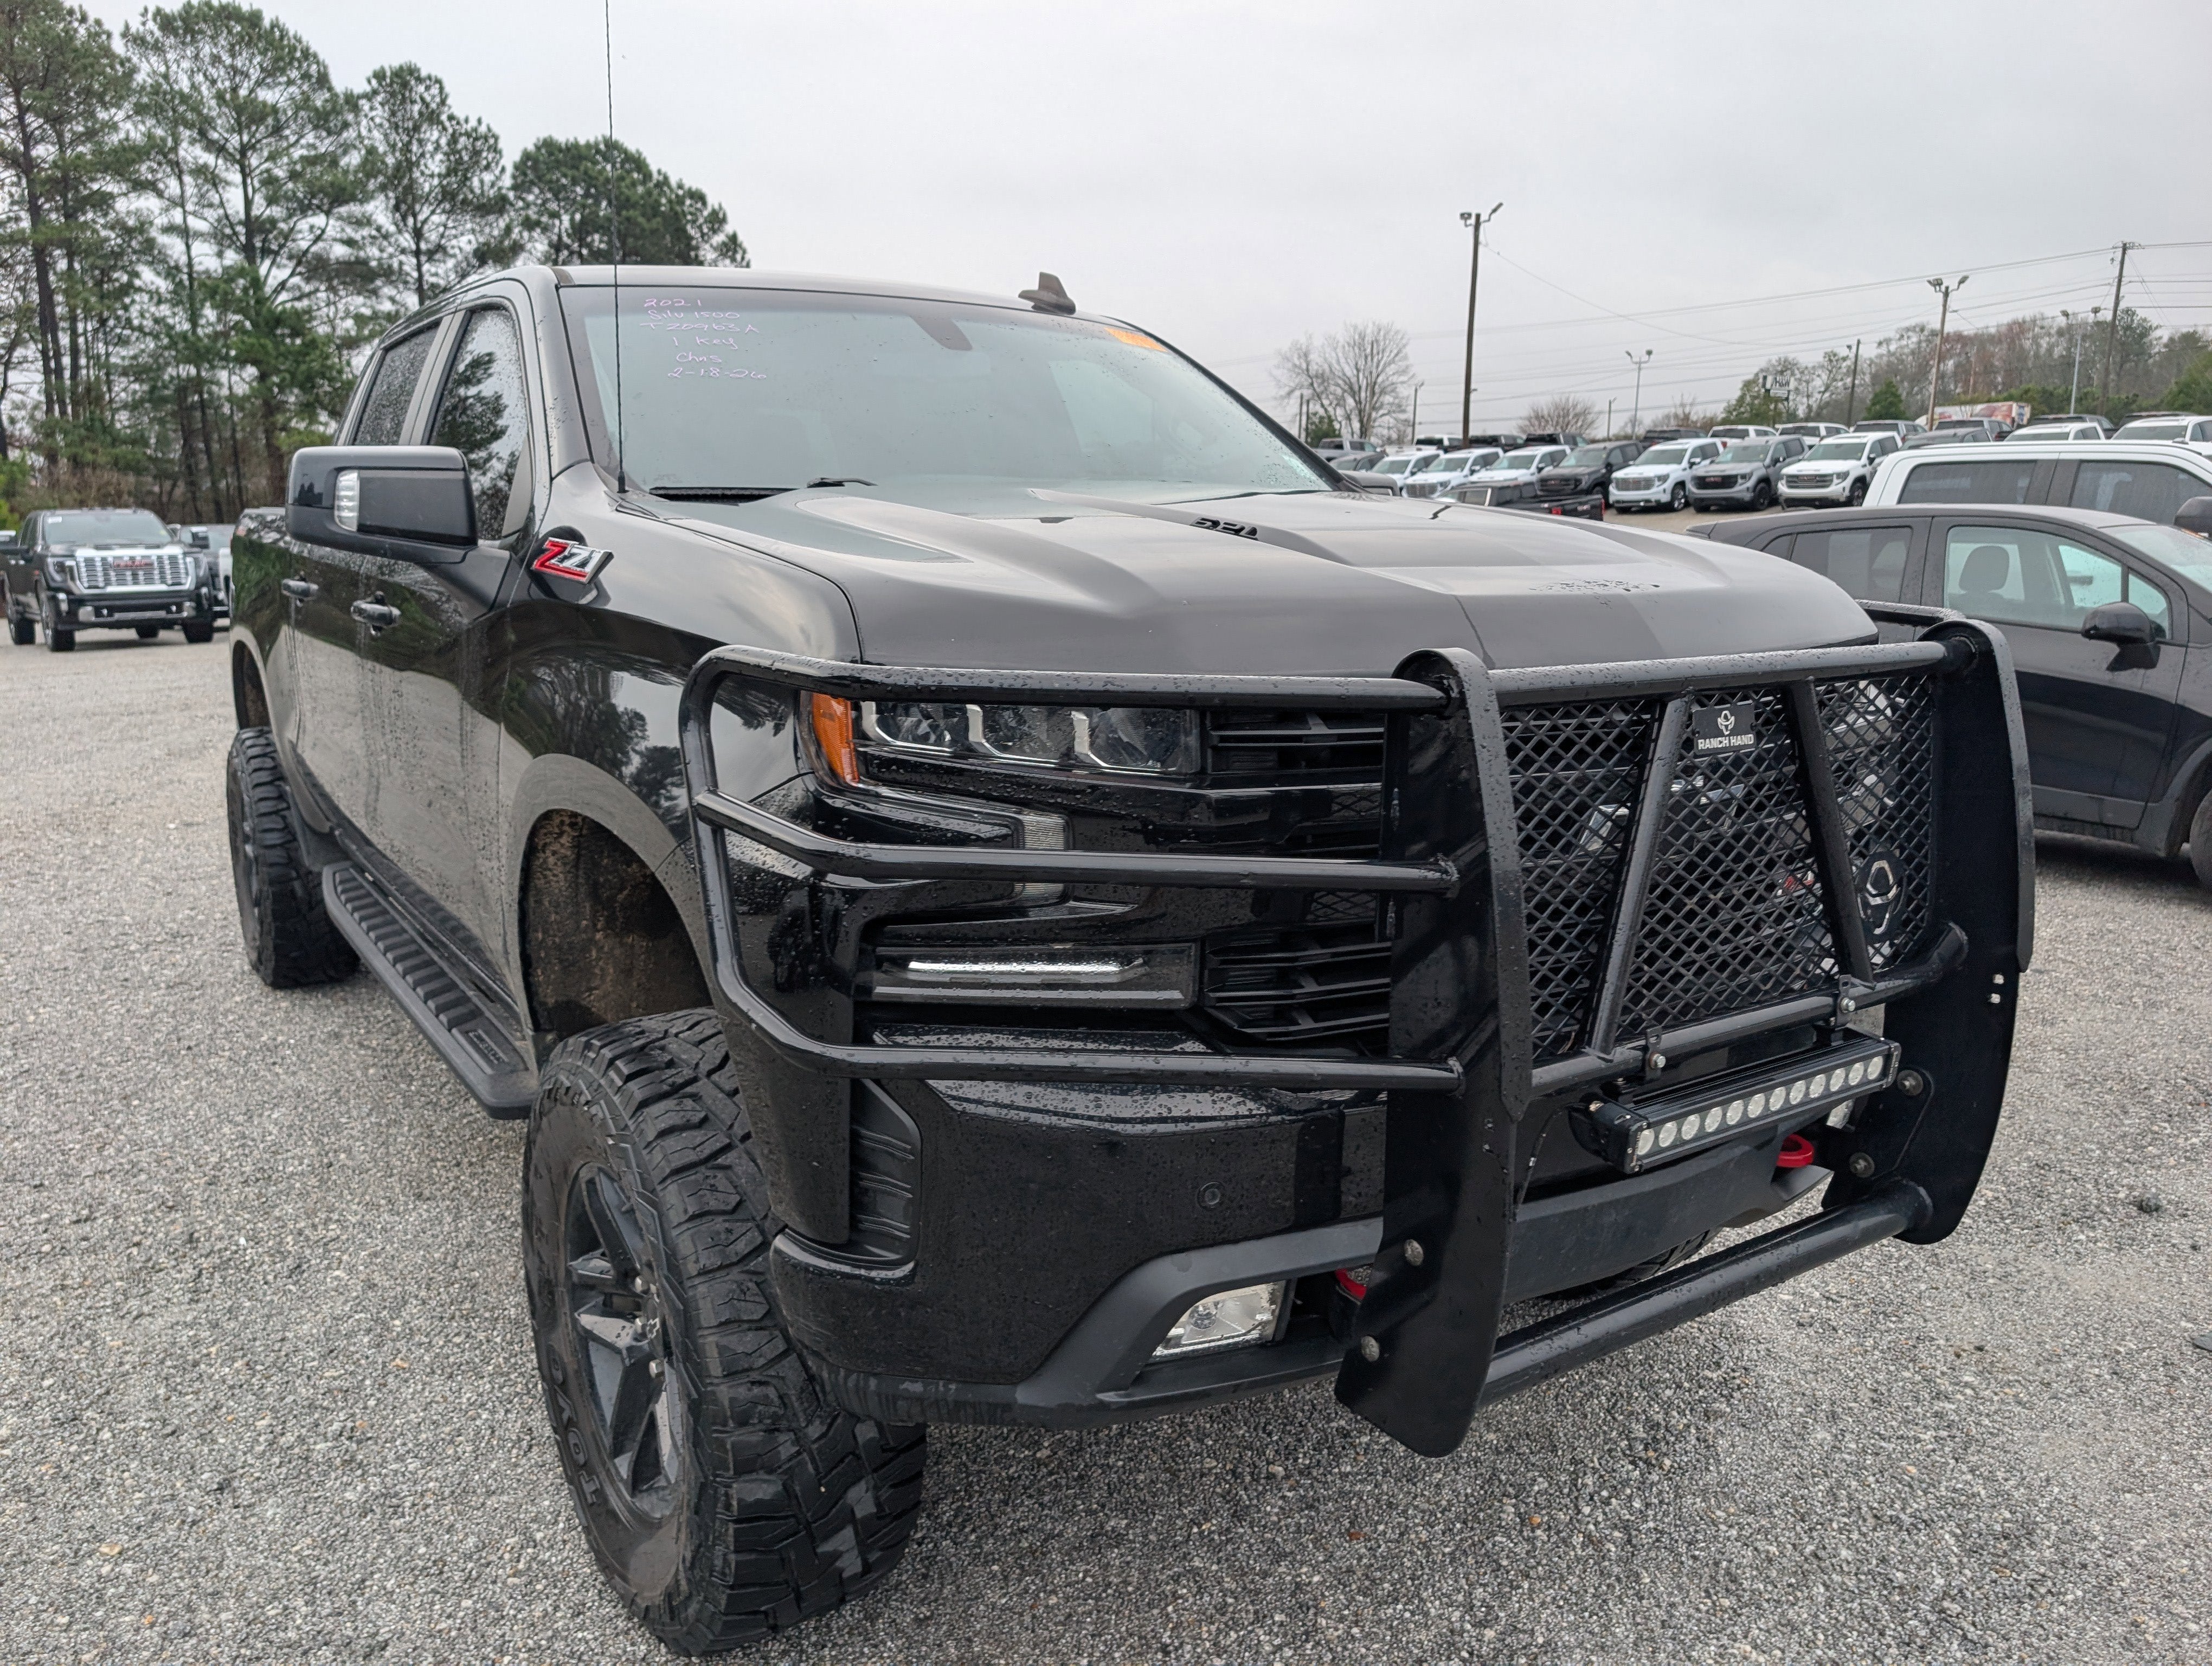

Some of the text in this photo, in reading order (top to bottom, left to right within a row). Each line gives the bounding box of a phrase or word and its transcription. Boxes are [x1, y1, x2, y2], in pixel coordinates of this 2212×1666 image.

[643, 297, 702, 308] 2021
[694, 311, 741, 319] 1500
[672, 336, 678, 347] 1
[531, 536, 614, 585] Z71
[1697, 734, 1754, 750] RANCH HAND
